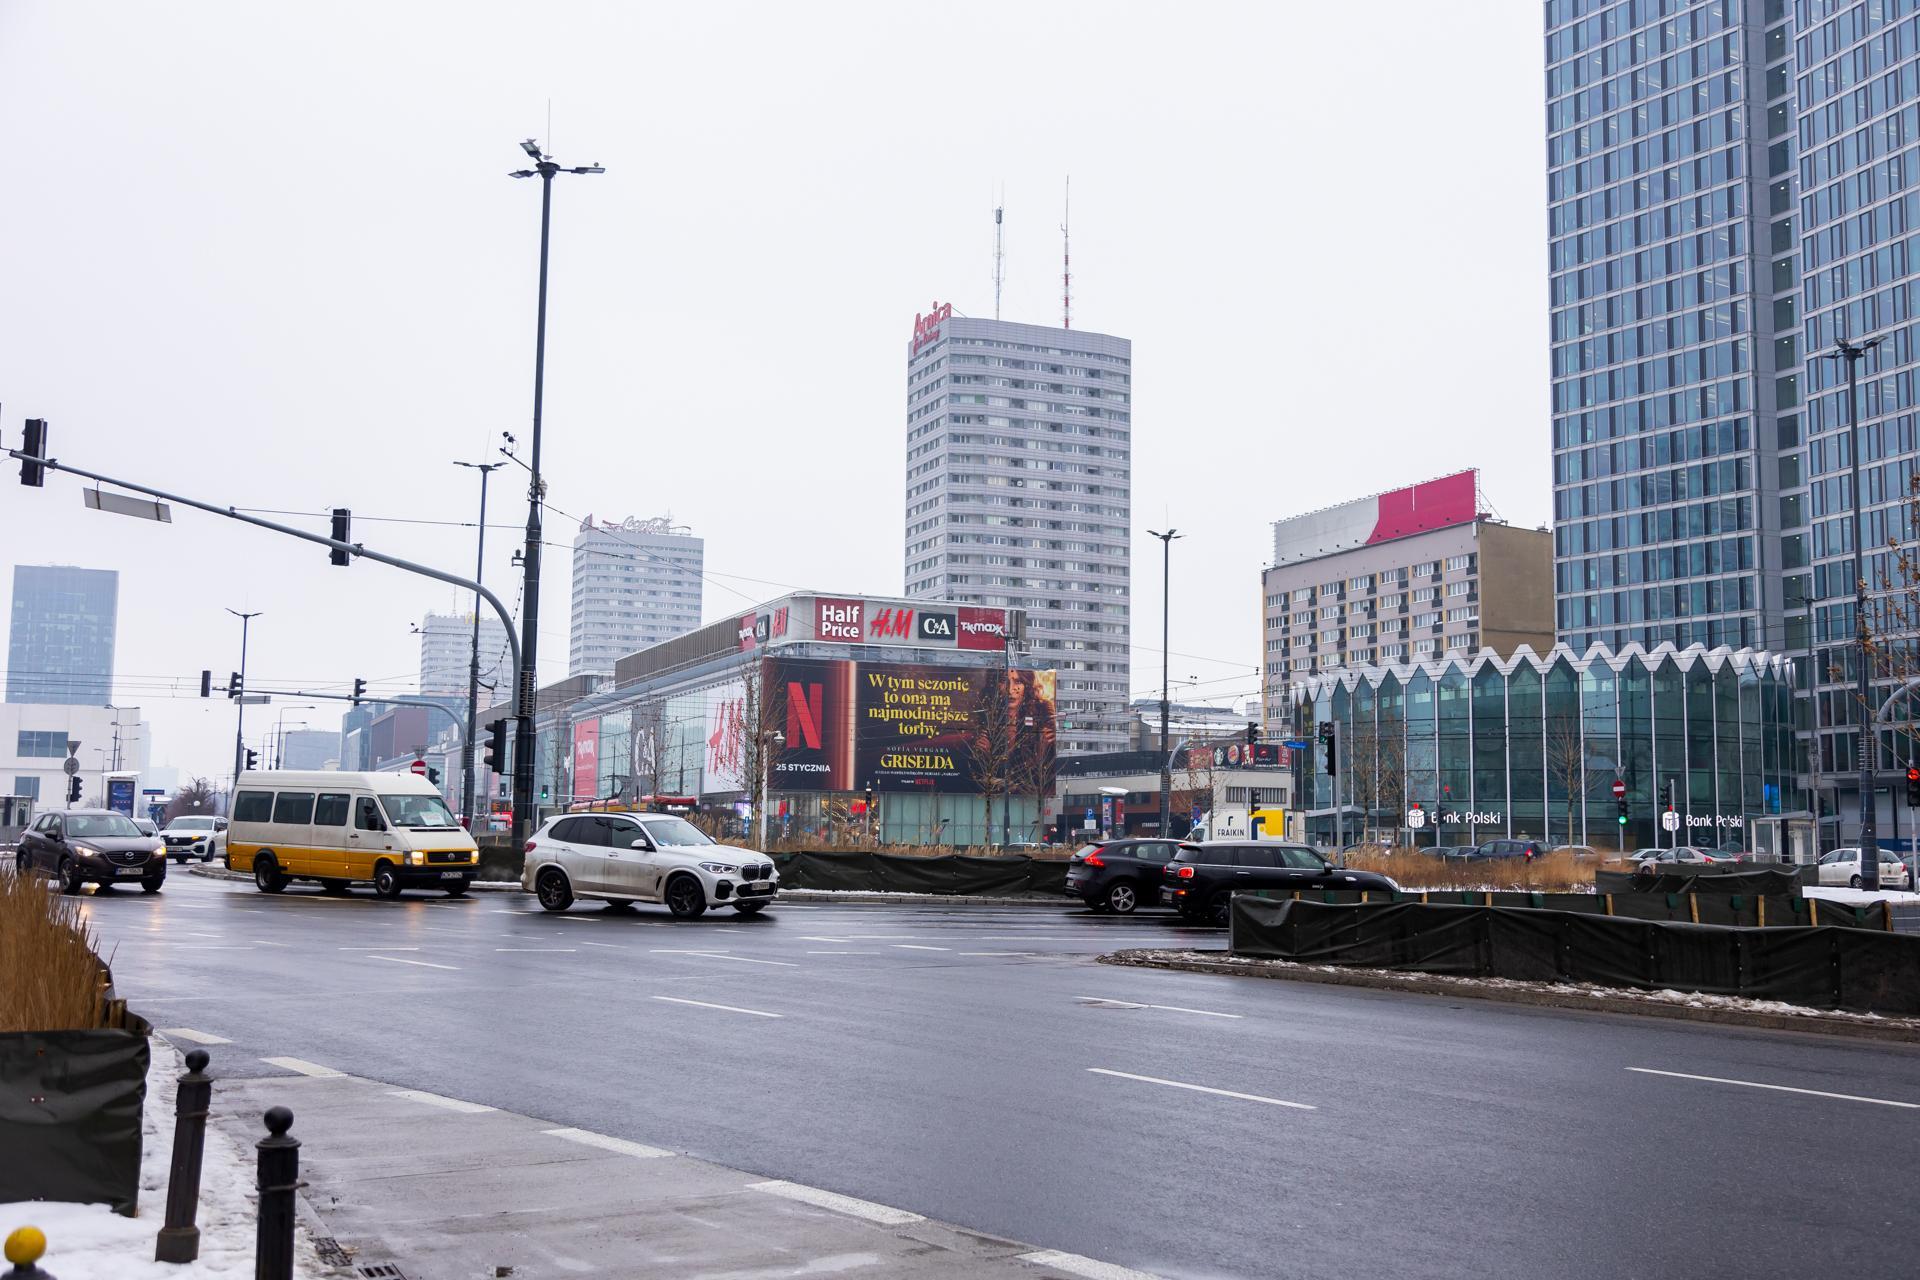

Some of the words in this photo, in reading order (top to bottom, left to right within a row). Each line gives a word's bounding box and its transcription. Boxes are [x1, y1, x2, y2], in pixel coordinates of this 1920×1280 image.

[822, 604, 860, 623] Half
[822, 621, 859, 638] Price
[870, 607, 914, 640] H&M
[923, 617, 951, 635] C&A
[868, 673, 886, 687] W
[888, 676, 914, 692] tym
[918, 677, 969, 692] sezonie
[884, 691, 899, 703] to
[901, 693, 927, 705] ona
[930, 694, 951, 706] ma
[786, 682, 822, 750] N
[868, 704, 969, 724] najmodniejsze
[899, 721, 940, 738] torby.
[776, 763, 787, 771] 25
[788, 764, 831, 772] STYCZNIA
[880, 754, 955, 770] GRISELDA
[1465, 811, 1501, 824] Polski
[1685, 814, 1713, 827] Bank
[1217, 828, 1245, 837] FRAIKIN
